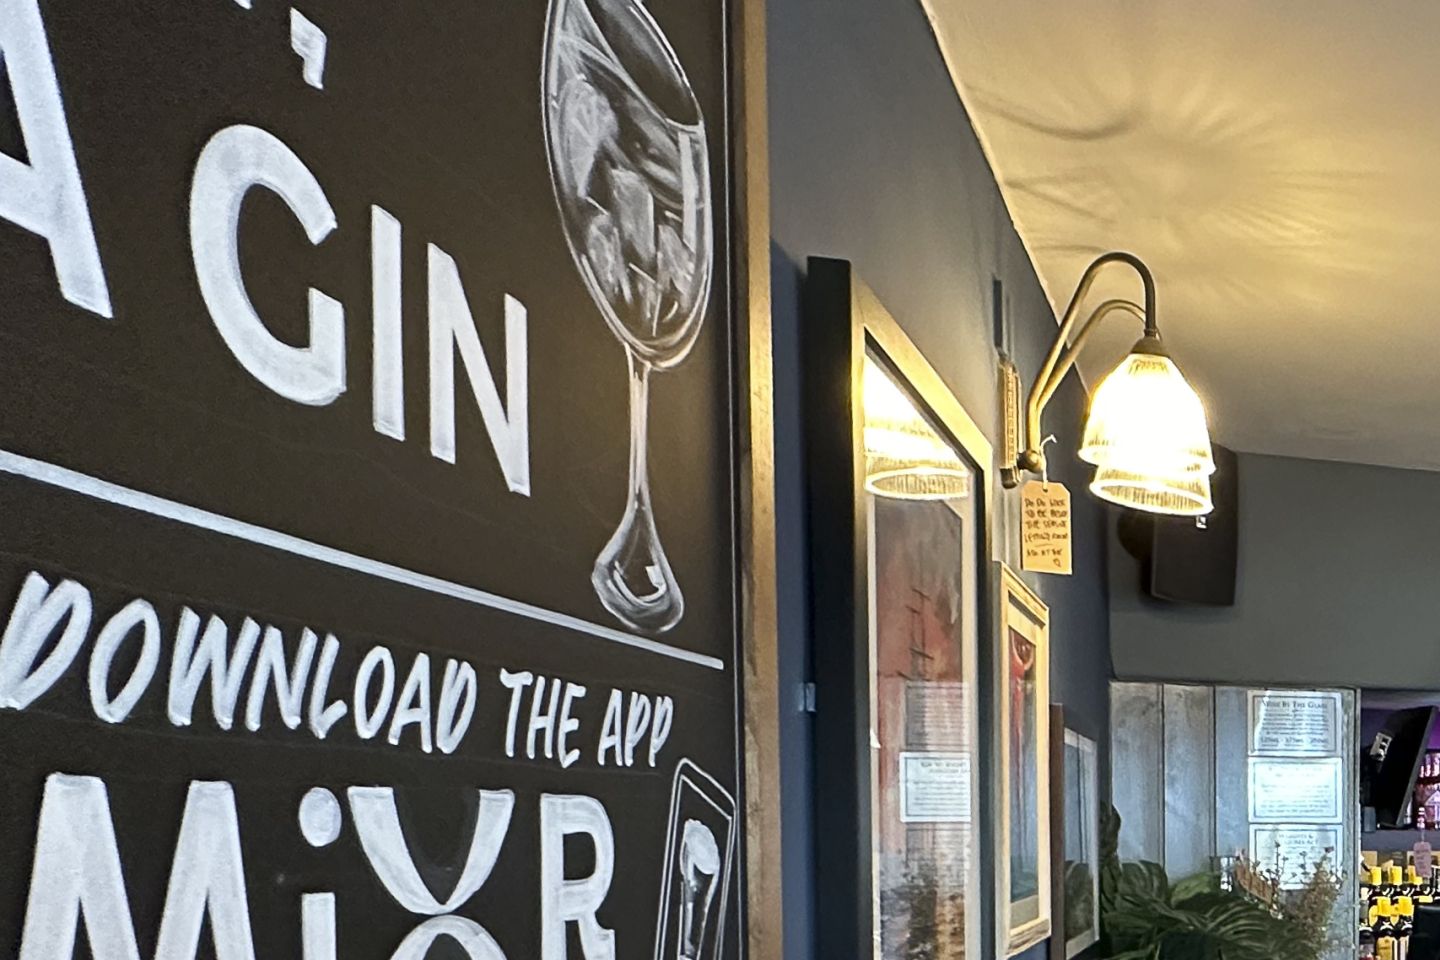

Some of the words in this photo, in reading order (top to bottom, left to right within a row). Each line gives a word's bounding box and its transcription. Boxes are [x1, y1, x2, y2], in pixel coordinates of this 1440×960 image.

[190, 124, 530, 497] GIN
[0, 571, 478, 754] DOWNLOAD
[500, 667, 587, 768] THE
[599, 687, 674, 768] APP
